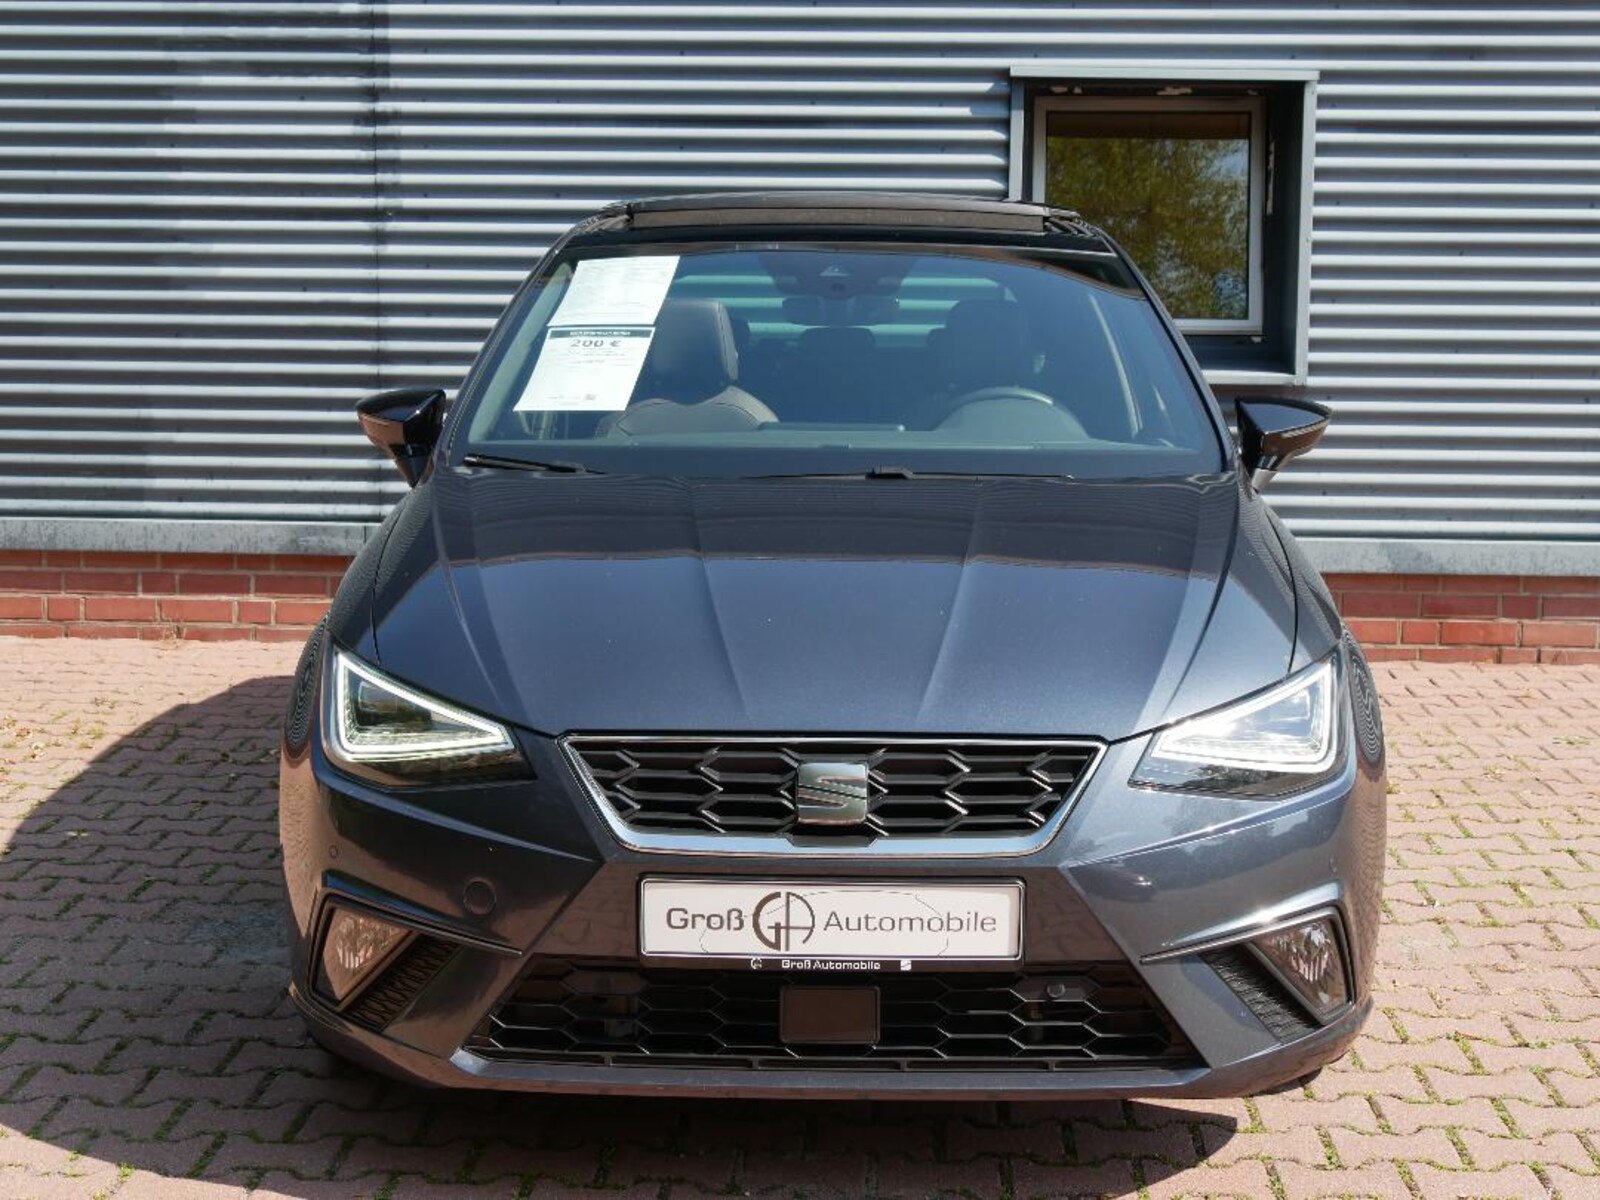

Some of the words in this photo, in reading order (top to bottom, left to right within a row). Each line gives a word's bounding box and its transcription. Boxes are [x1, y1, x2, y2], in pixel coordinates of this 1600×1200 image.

[570, 338, 604, 348] 200
[610, 339, 622, 348] €
[666, 908, 744, 930] Groß
[823, 911, 997, 932] Automobile
[781, 959, 811, 970] Groß
[813, 959, 881, 970] Automobile
